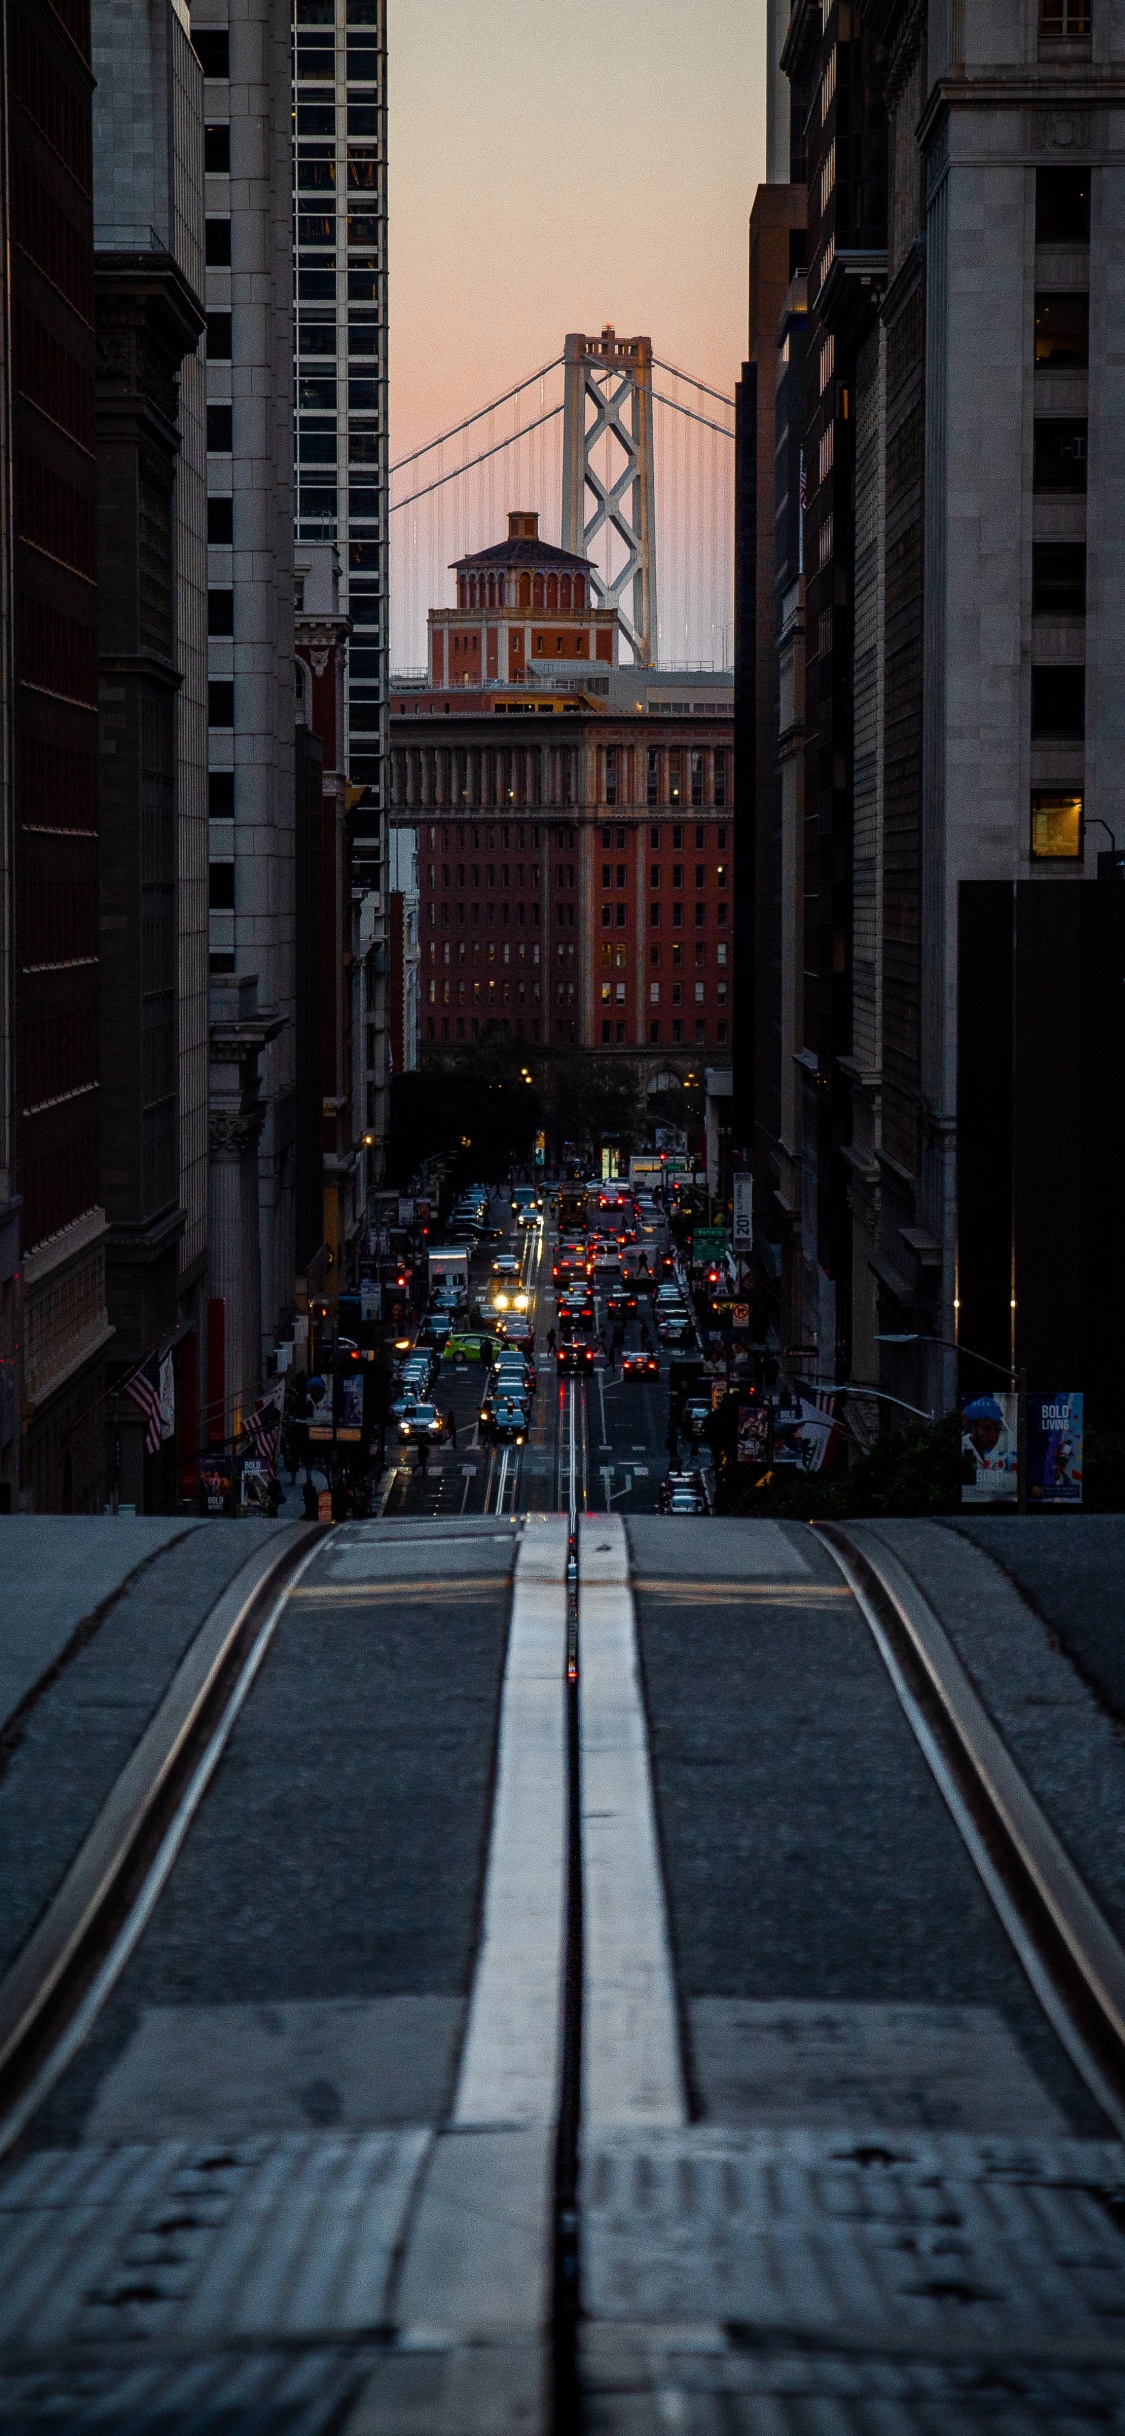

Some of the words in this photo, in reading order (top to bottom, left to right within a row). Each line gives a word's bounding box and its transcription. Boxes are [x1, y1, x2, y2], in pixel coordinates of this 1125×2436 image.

[1060, 437, 1085, 459] HI
[736, 1215, 749, 1235] 201
[343, 1379, 357, 1387] BOLD
[1041, 1405, 1069, 1418] BOLD
[1041, 1419, 1069, 1430] LIVING
[244, 1461, 261, 1469] BOLD
[207, 1496, 224, 1504] BOLD
